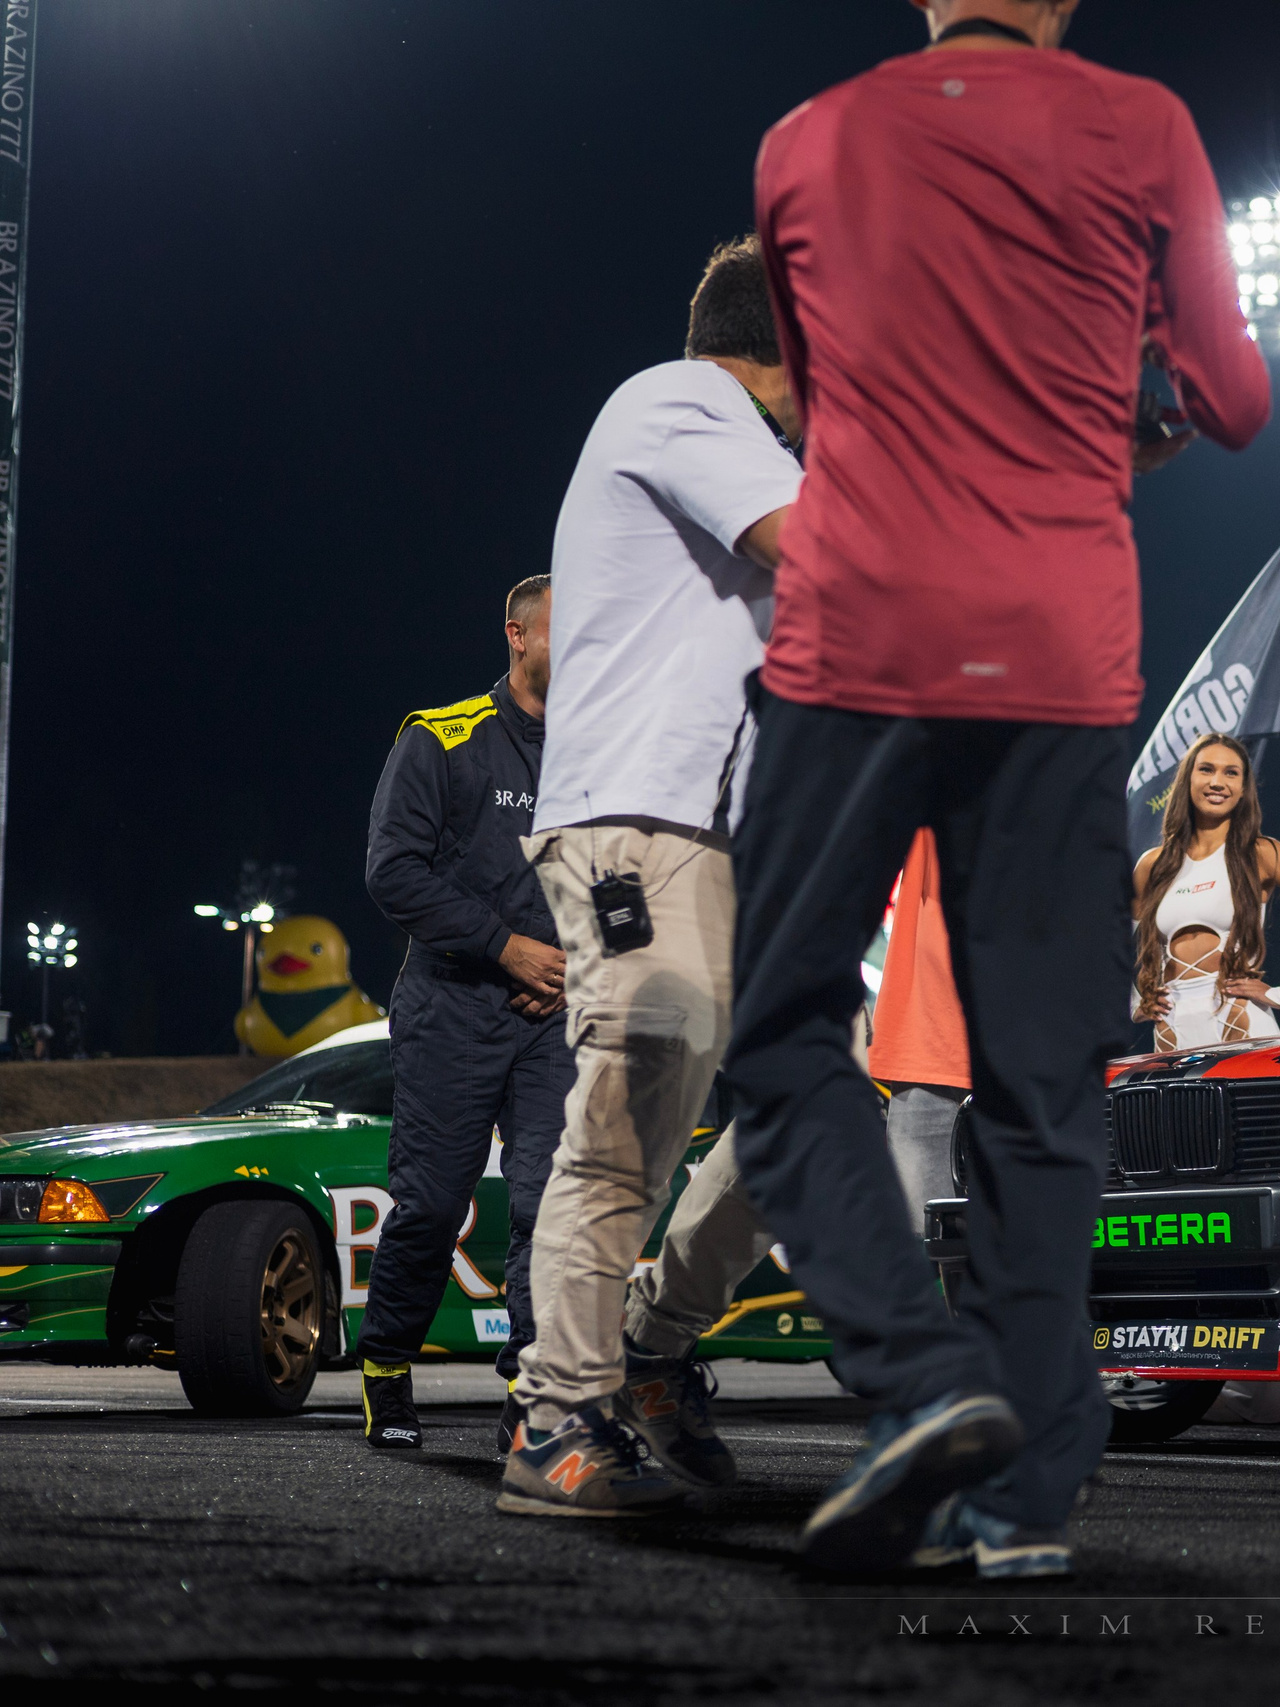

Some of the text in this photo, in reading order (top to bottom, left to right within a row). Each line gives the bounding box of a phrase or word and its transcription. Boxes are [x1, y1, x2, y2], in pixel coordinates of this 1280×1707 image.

[0, 0, 28, 163] RAZINO777
[442, 725, 465, 737] OMP
[1112, 1325, 1265, 1350] STAYKI DRIFT
[382, 1428, 418, 1440] OMP
